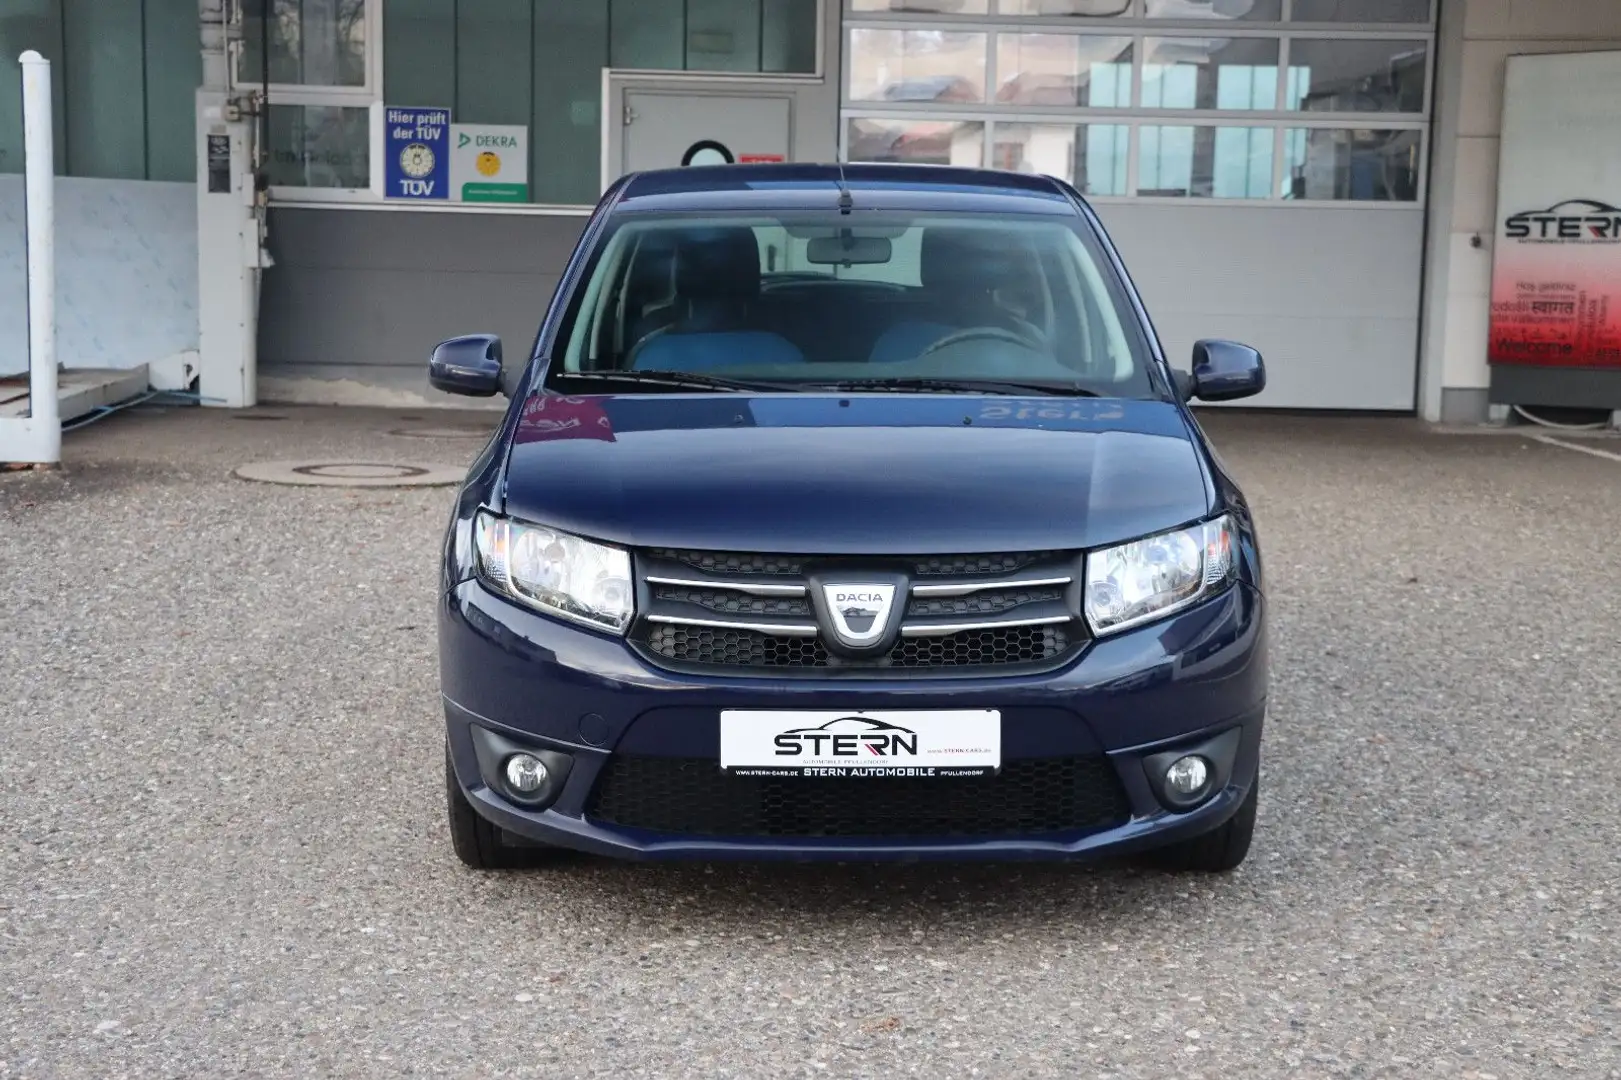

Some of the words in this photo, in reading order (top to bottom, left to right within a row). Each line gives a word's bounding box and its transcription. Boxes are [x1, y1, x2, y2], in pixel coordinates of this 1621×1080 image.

[388, 110, 414, 123] Hier
[416, 112, 446, 126] prüft
[393, 126, 414, 139] der
[416, 125, 441, 140] TÜV
[475, 135, 517, 148] DEKRA
[836, 593, 883, 602] DACIA
[774, 734, 917, 756] STERN
[803, 767, 846, 777] STERN
[850, 767, 935, 777] AUTOMOBILE
[940, 769, 984, 777] PFULLENDORF
